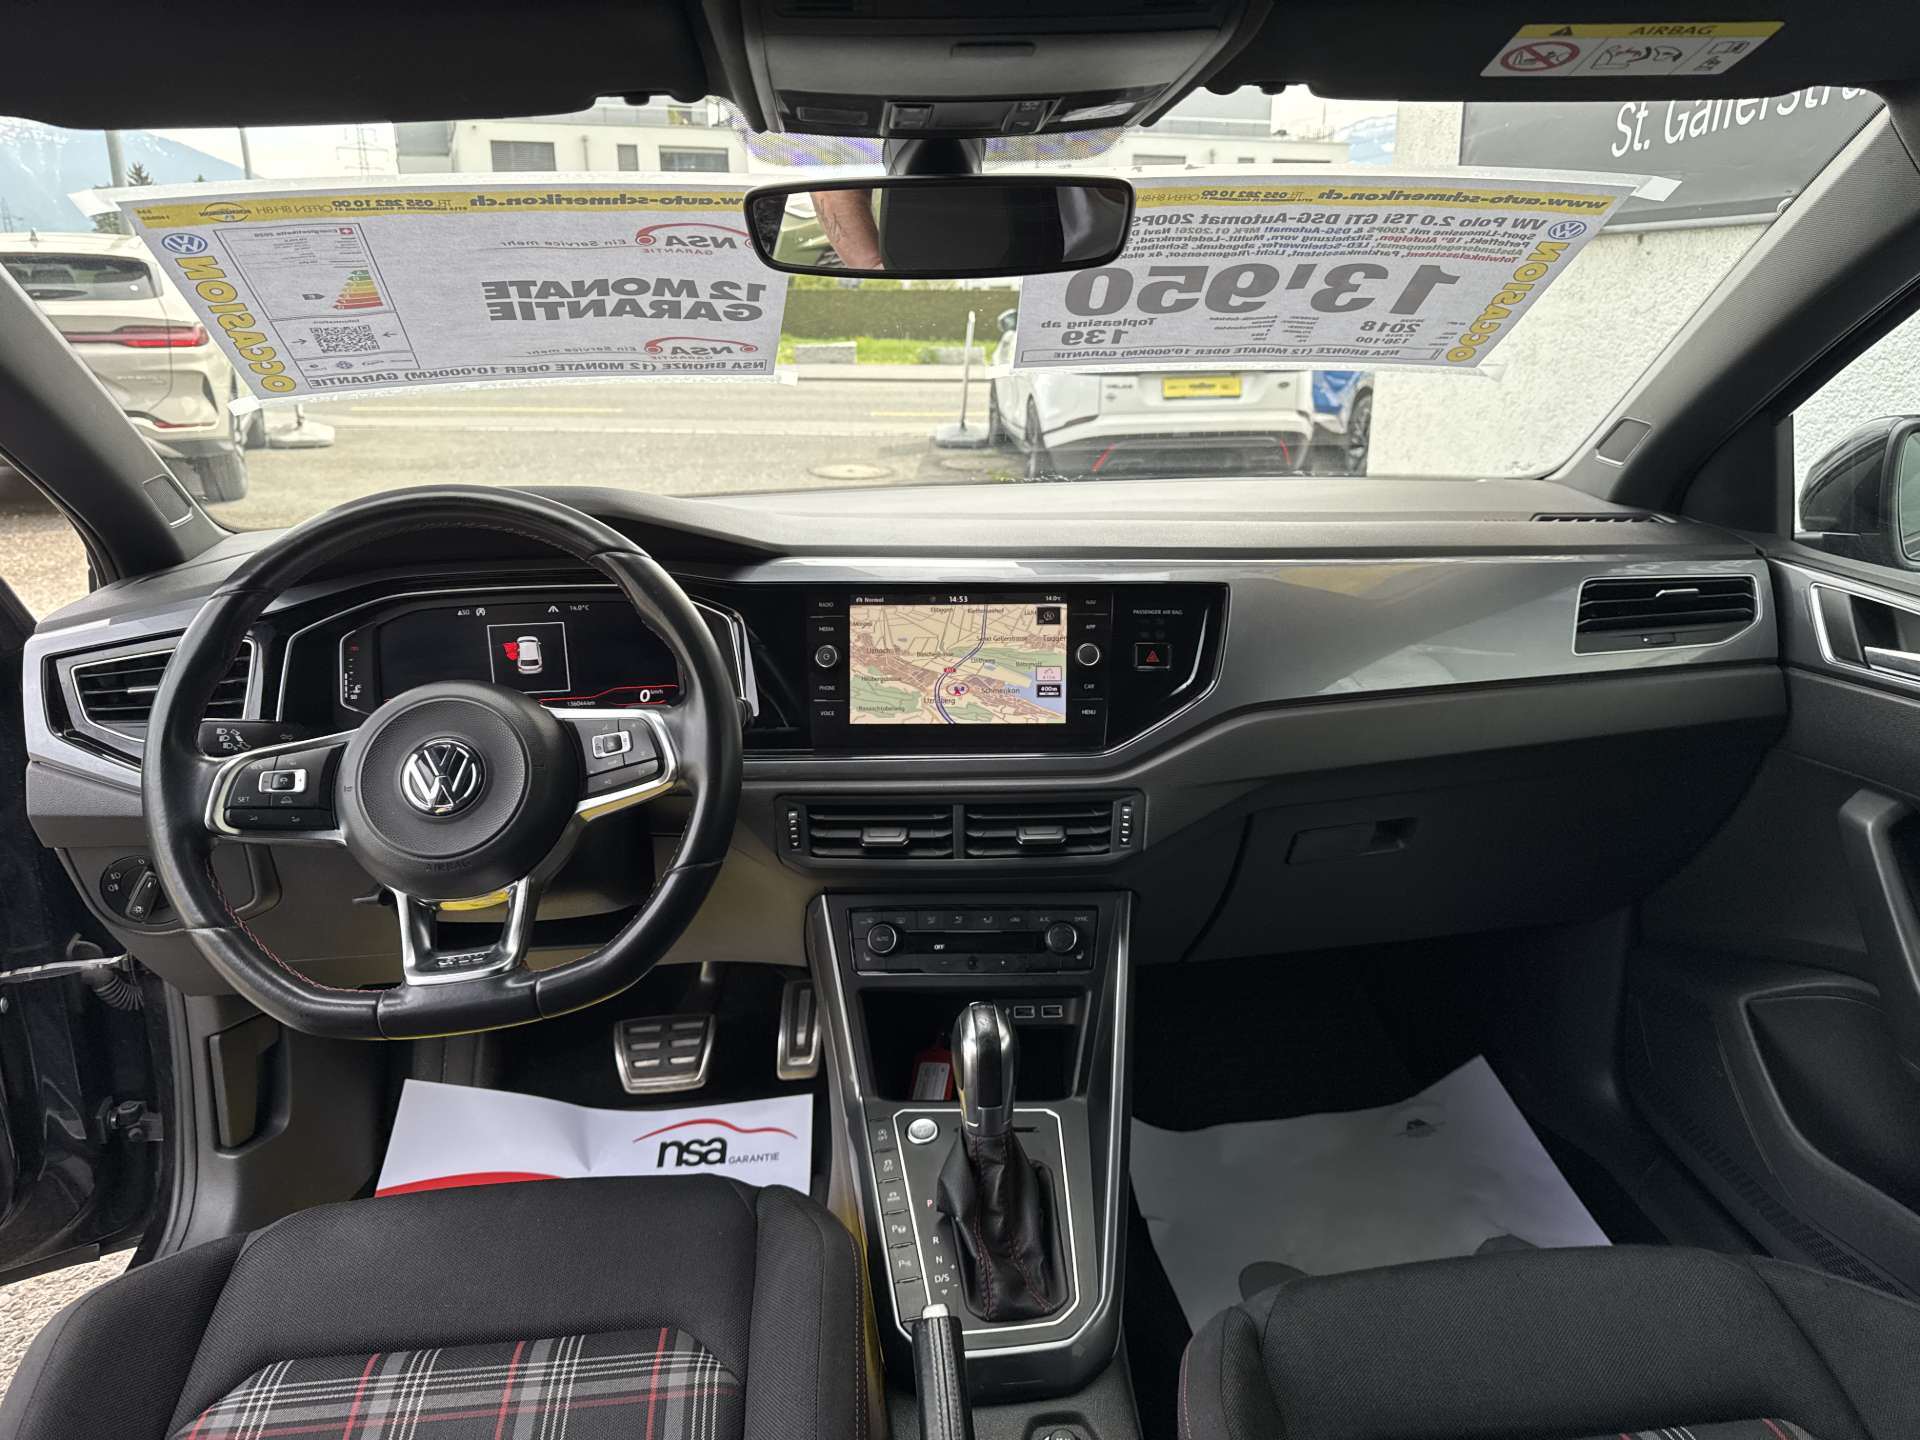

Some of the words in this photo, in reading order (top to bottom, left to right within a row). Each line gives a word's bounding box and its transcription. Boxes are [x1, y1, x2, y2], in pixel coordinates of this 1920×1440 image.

[1629, 25, 1717, 36] AIRBAG
[1611, 101, 1651, 157] St.
[949, 595, 968, 603] 14:53
[640, 689, 651, 703] 0
[656, 1136, 728, 1169] nsa
[728, 1151, 780, 1165] GARANTIE
[926, 1199, 934, 1208] P
[932, 1236, 940, 1245] R
[935, 1255, 943, 1265] N
[934, 1273, 951, 1284] D/S
